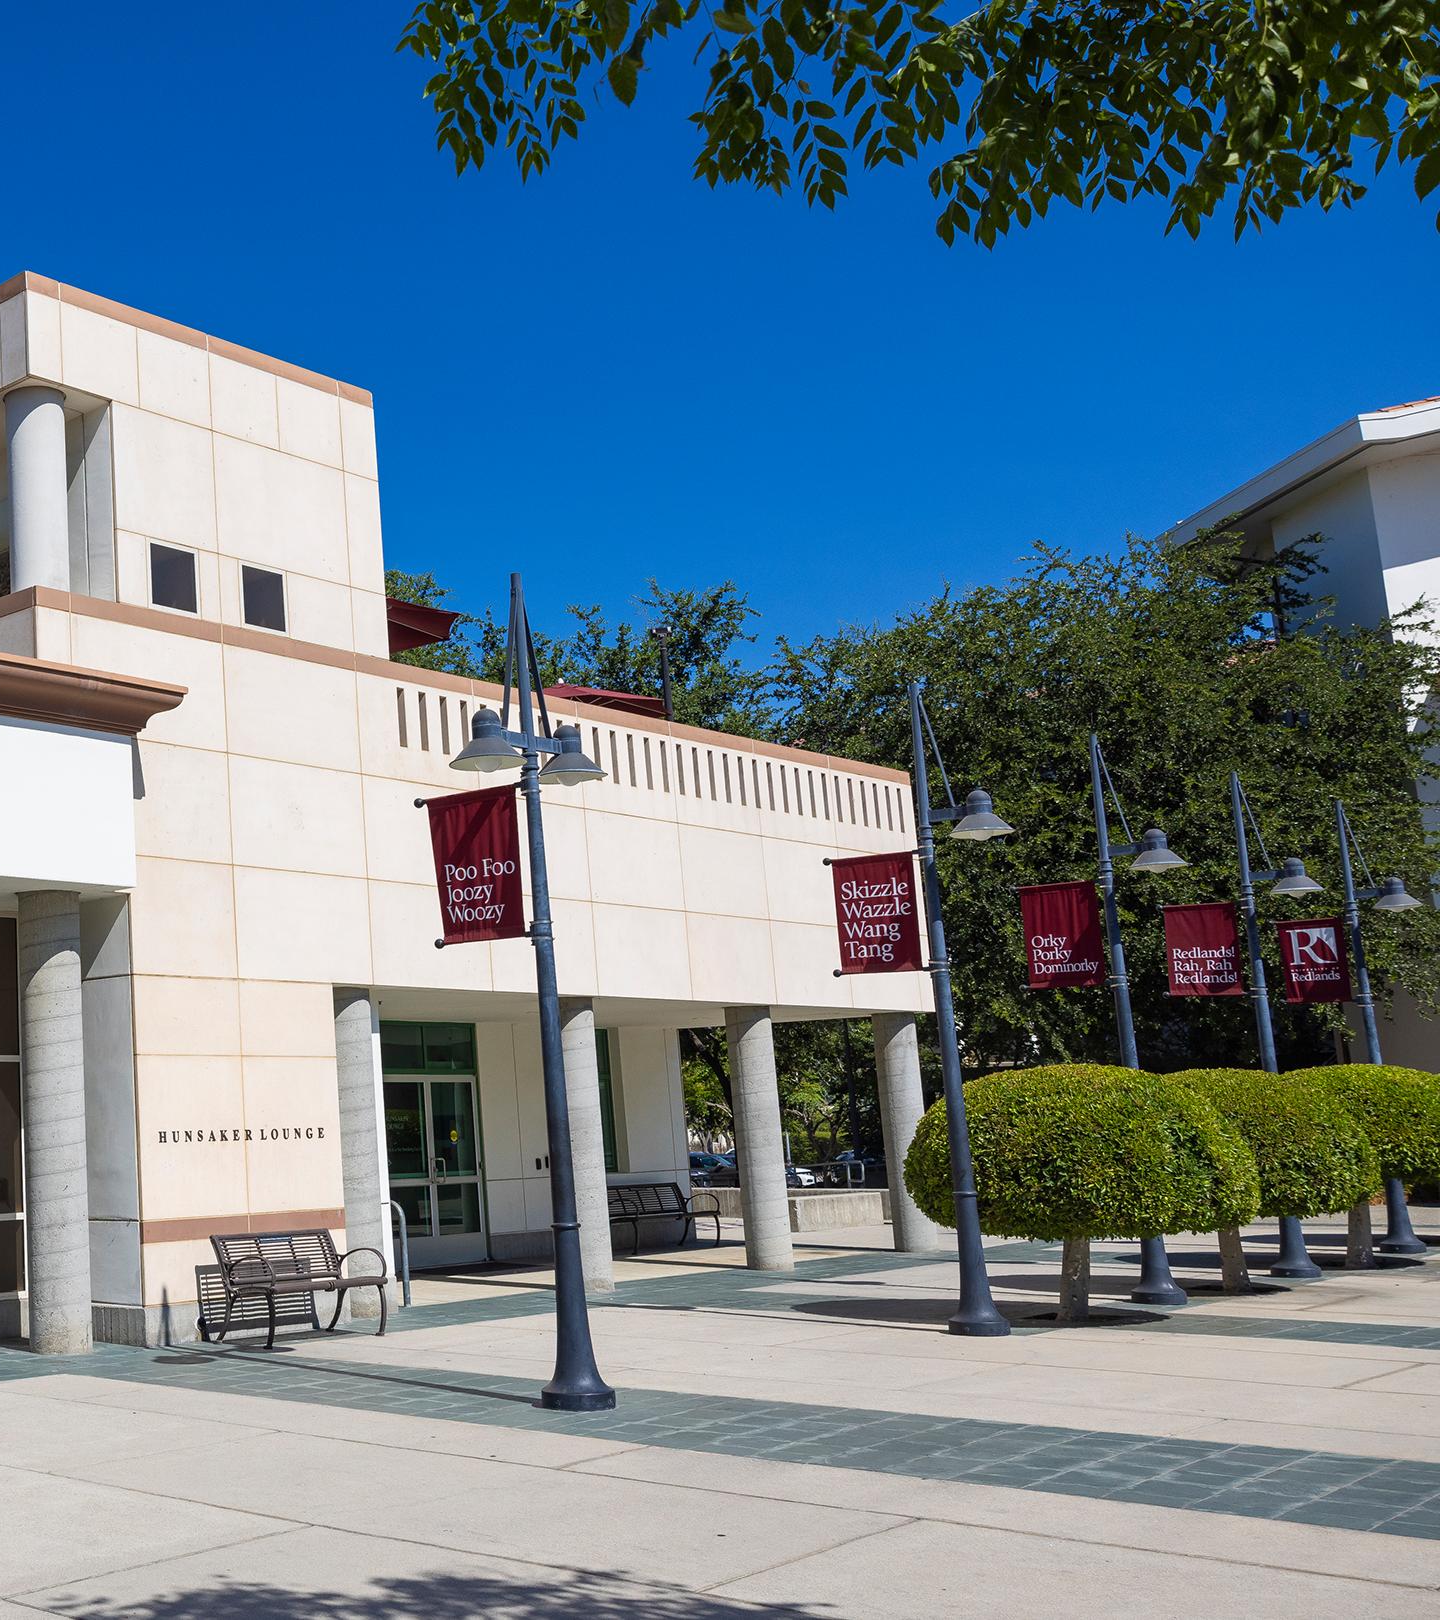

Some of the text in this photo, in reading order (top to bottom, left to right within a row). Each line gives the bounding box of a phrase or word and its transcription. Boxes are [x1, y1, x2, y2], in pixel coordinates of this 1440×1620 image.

[444, 858, 516, 883] Poo Foo
[446, 884, 494, 906] Joozy
[840, 877, 908, 900] Skizzle
[447, 903, 505, 924] Woozy
[841, 897, 912, 920] Wazzle
[843, 920, 901, 942] Wang
[1032, 934, 1067, 950] Orky
[844, 940, 894, 962] Tang
[1032, 947, 1072, 962] Porky
[1172, 946, 1235, 960] Redlands!
[1034, 958, 1098, 974] Dominorky
[1174, 958, 1232, 972] Rah, Rah
[1174, 971, 1238, 984] Redlands!
[1290, 970, 1340, 982] Redlands
[158, 1128, 324, 1144] HUNSAKER LOUNGE
